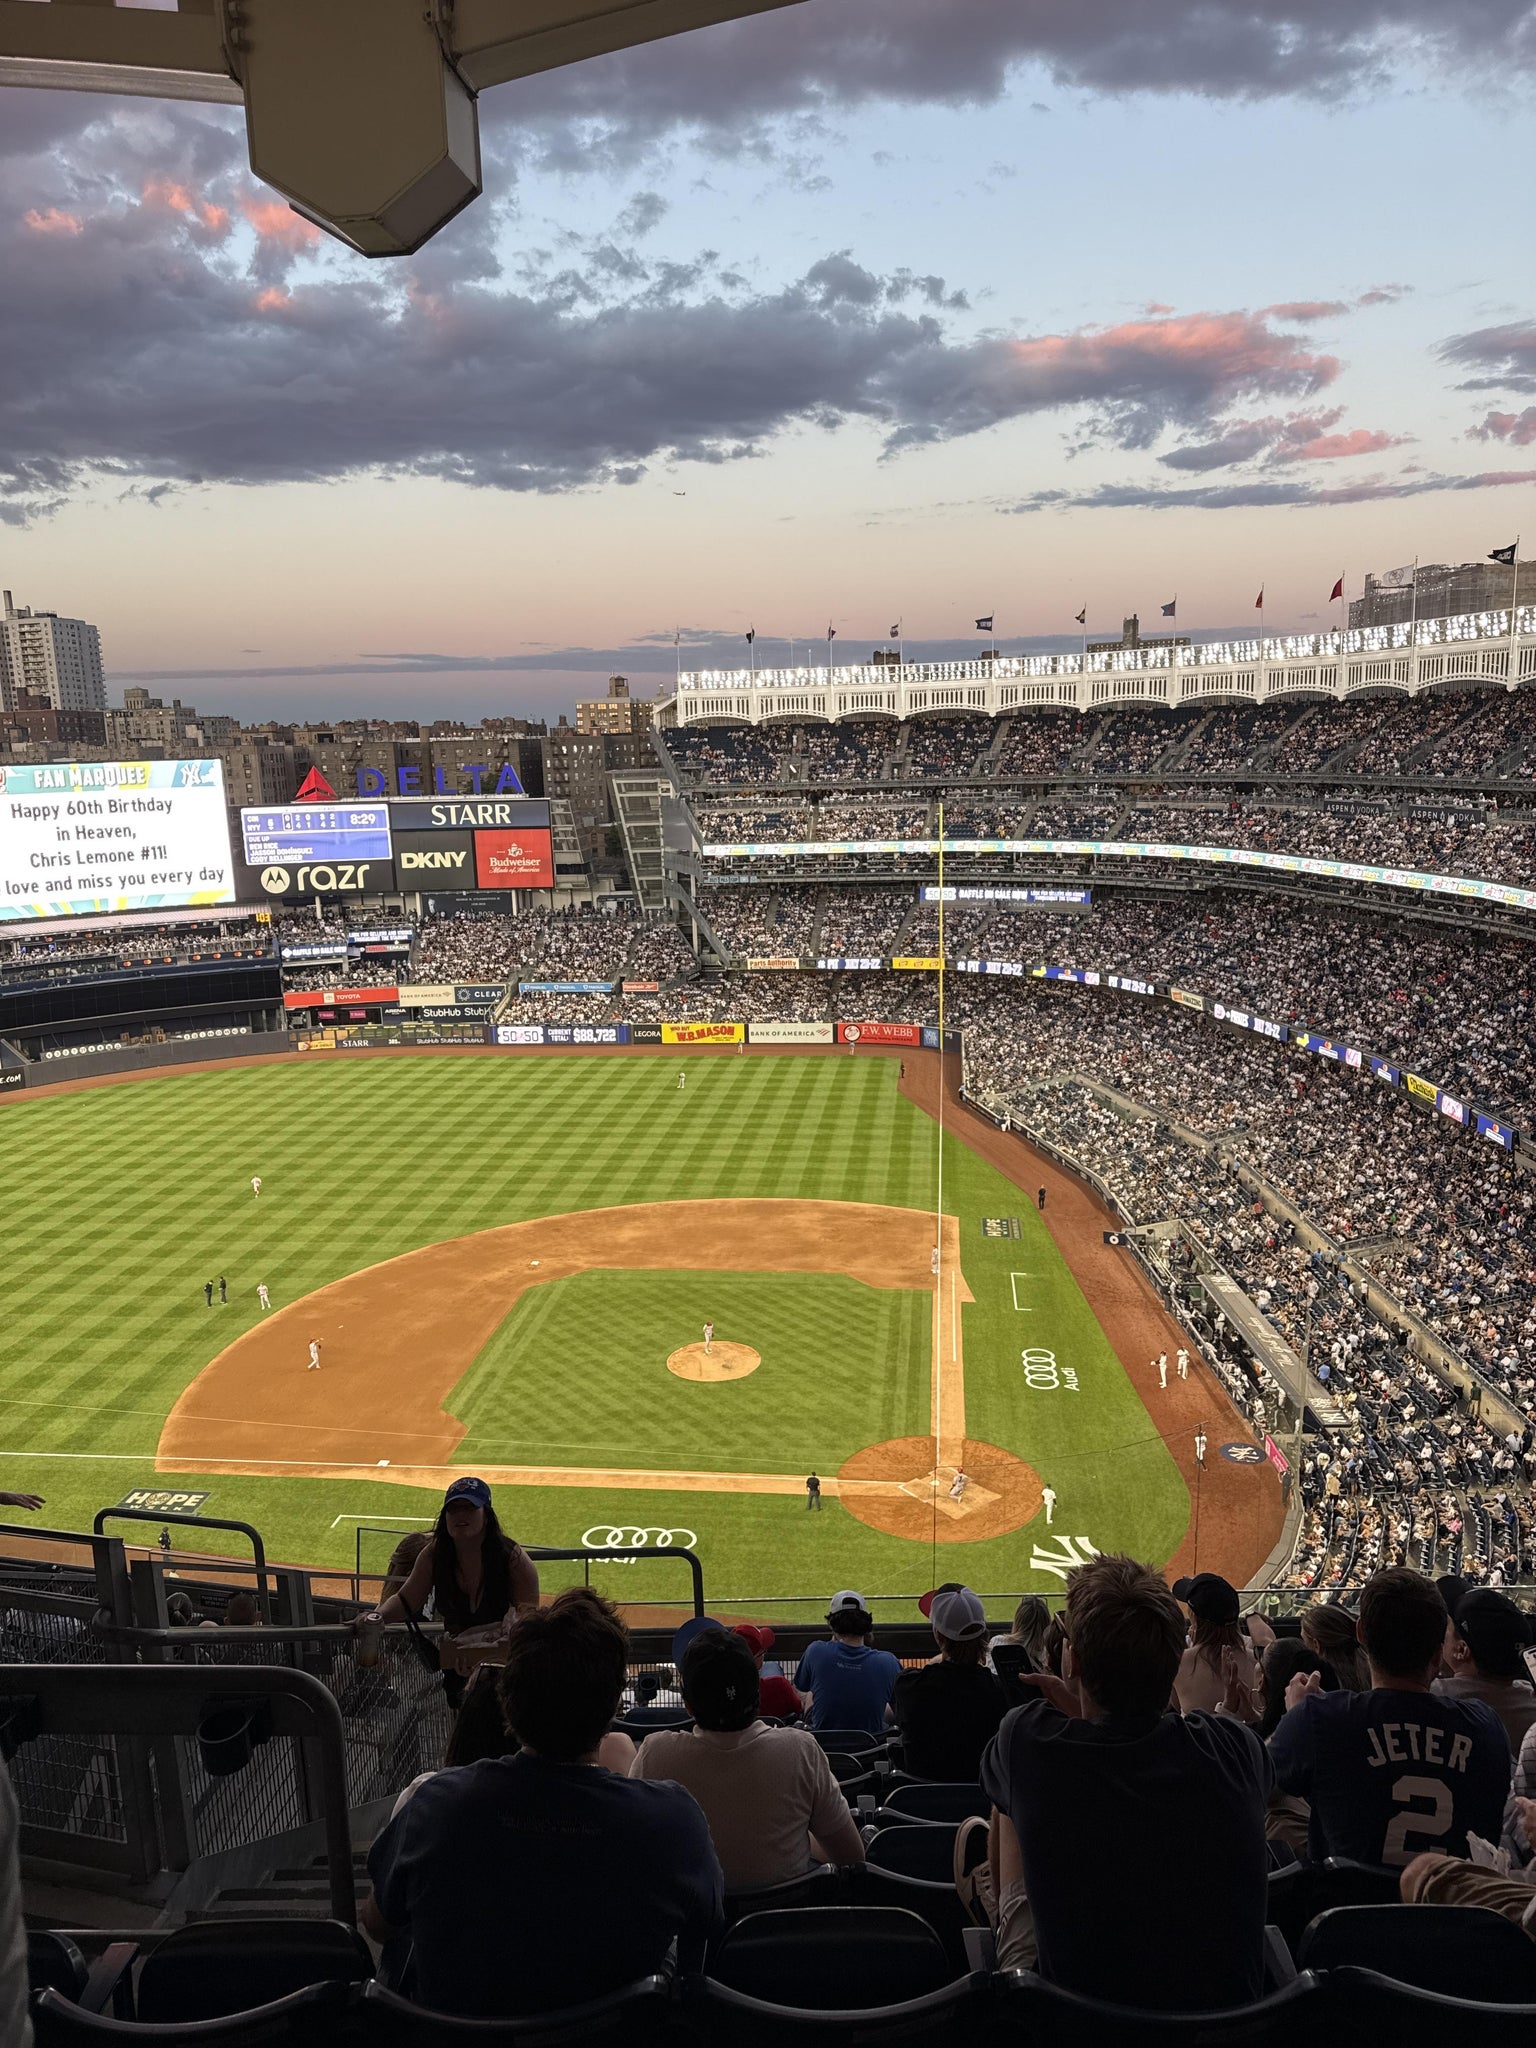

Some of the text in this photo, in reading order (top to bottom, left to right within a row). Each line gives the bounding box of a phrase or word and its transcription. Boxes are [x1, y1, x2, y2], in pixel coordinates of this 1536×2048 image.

[34, 766, 146, 788] FAN MARQUEE
[357, 765, 523, 796] DELTA
[11, 798, 173, 820] Happy 60th Birthday
[431, 804, 511, 825] STARR
[1327, 805, 1380, 815] ASPEN VODKA
[1411, 810, 1438, 820] ASPEN
[350, 813, 376, 825] 8:29
[56, 824, 137, 841] in Heaven,
[30, 845, 167, 868] Chris Lemone #11!
[401, 851, 466, 869] DKNY
[489, 857, 541, 866] Budweiser
[5, 865, 225, 895] love and miss you every day
[297, 864, 370, 891] razr
[767, 959, 797, 968] Authority
[423, 1008, 461, 1018] StubHub
[503, 1031, 539, 1042] 50 50
[573, 1027, 616, 1043] $88,722
[862, 1026, 913, 1037] F.W. WEBB
[1064, 1366, 1080, 1392] Audi
[125, 1491, 204, 1507] HOPE
[1366, 1723, 1473, 1773] JETER
[1382, 1775, 1453, 1867] 2
